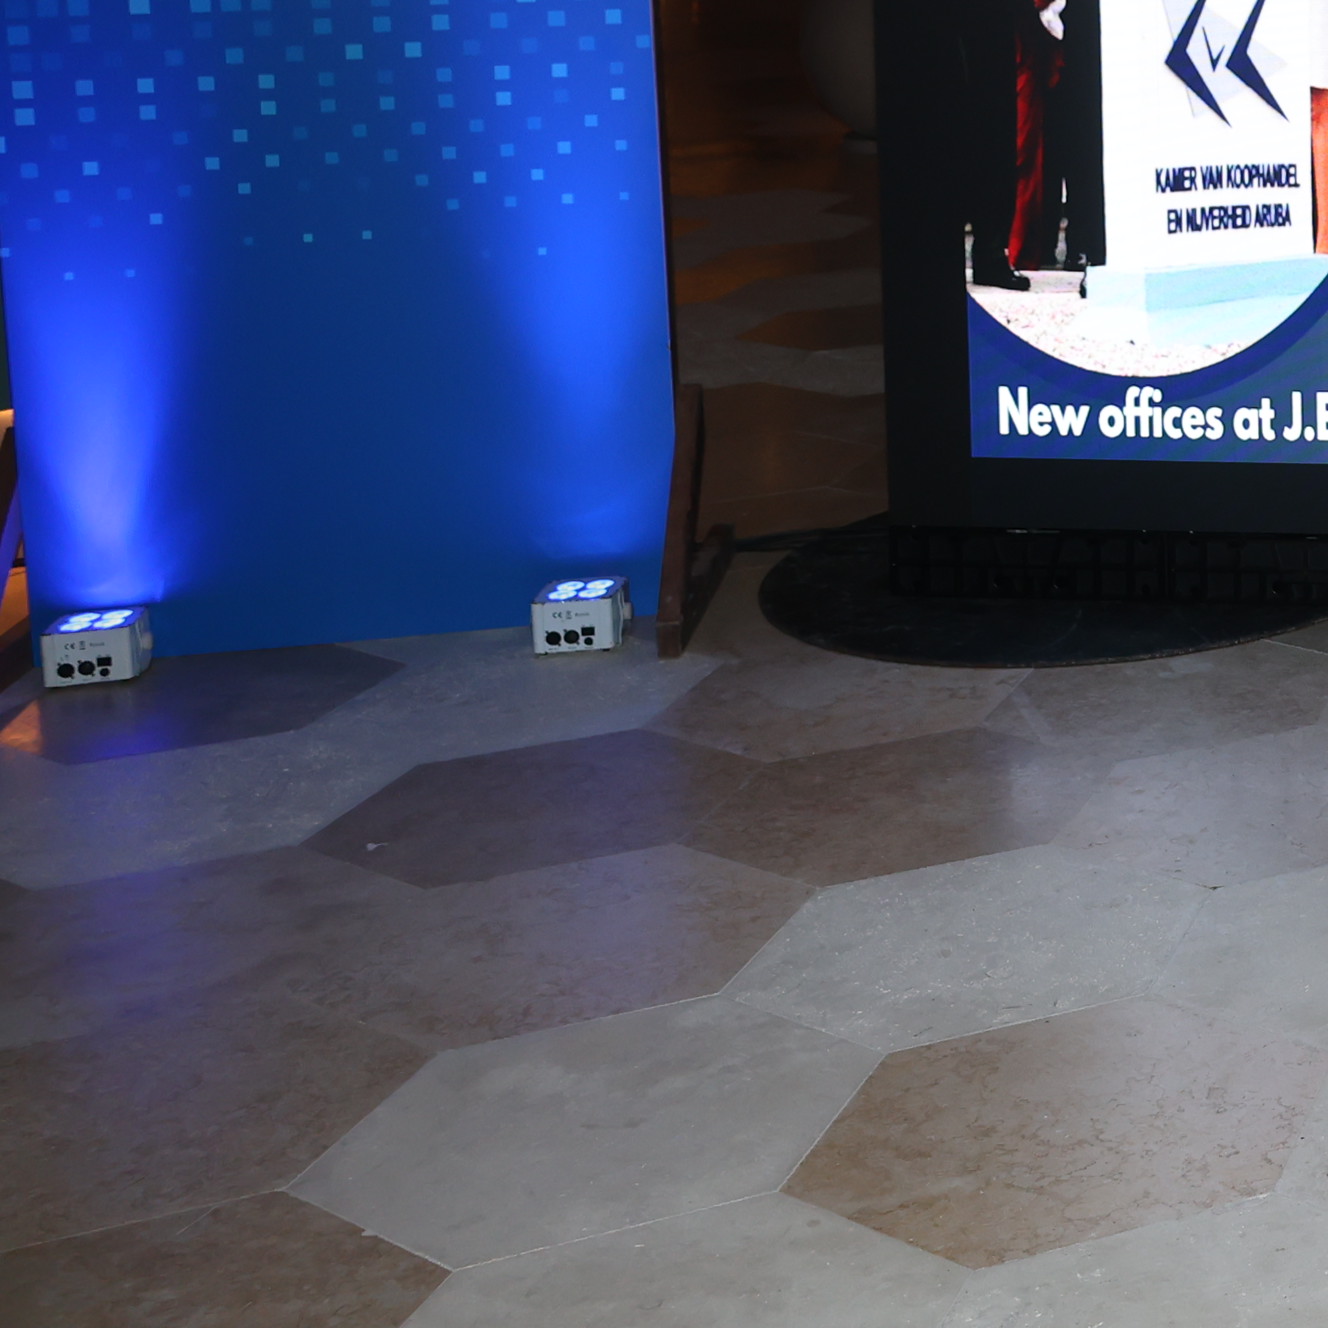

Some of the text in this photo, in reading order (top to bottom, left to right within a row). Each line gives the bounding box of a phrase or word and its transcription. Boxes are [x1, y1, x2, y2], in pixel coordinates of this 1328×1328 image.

[1200, 165, 1223, 190] VAN
[1226, 163, 1300, 188] KOOPHANDEL
[1167, 209, 1183, 234] EN
[1254, 203, 1292, 228] ARUBA
[998, 386, 1090, 436] New
[1099, 386, 1224, 440] offices
[1233, 398, 1276, 441] at
